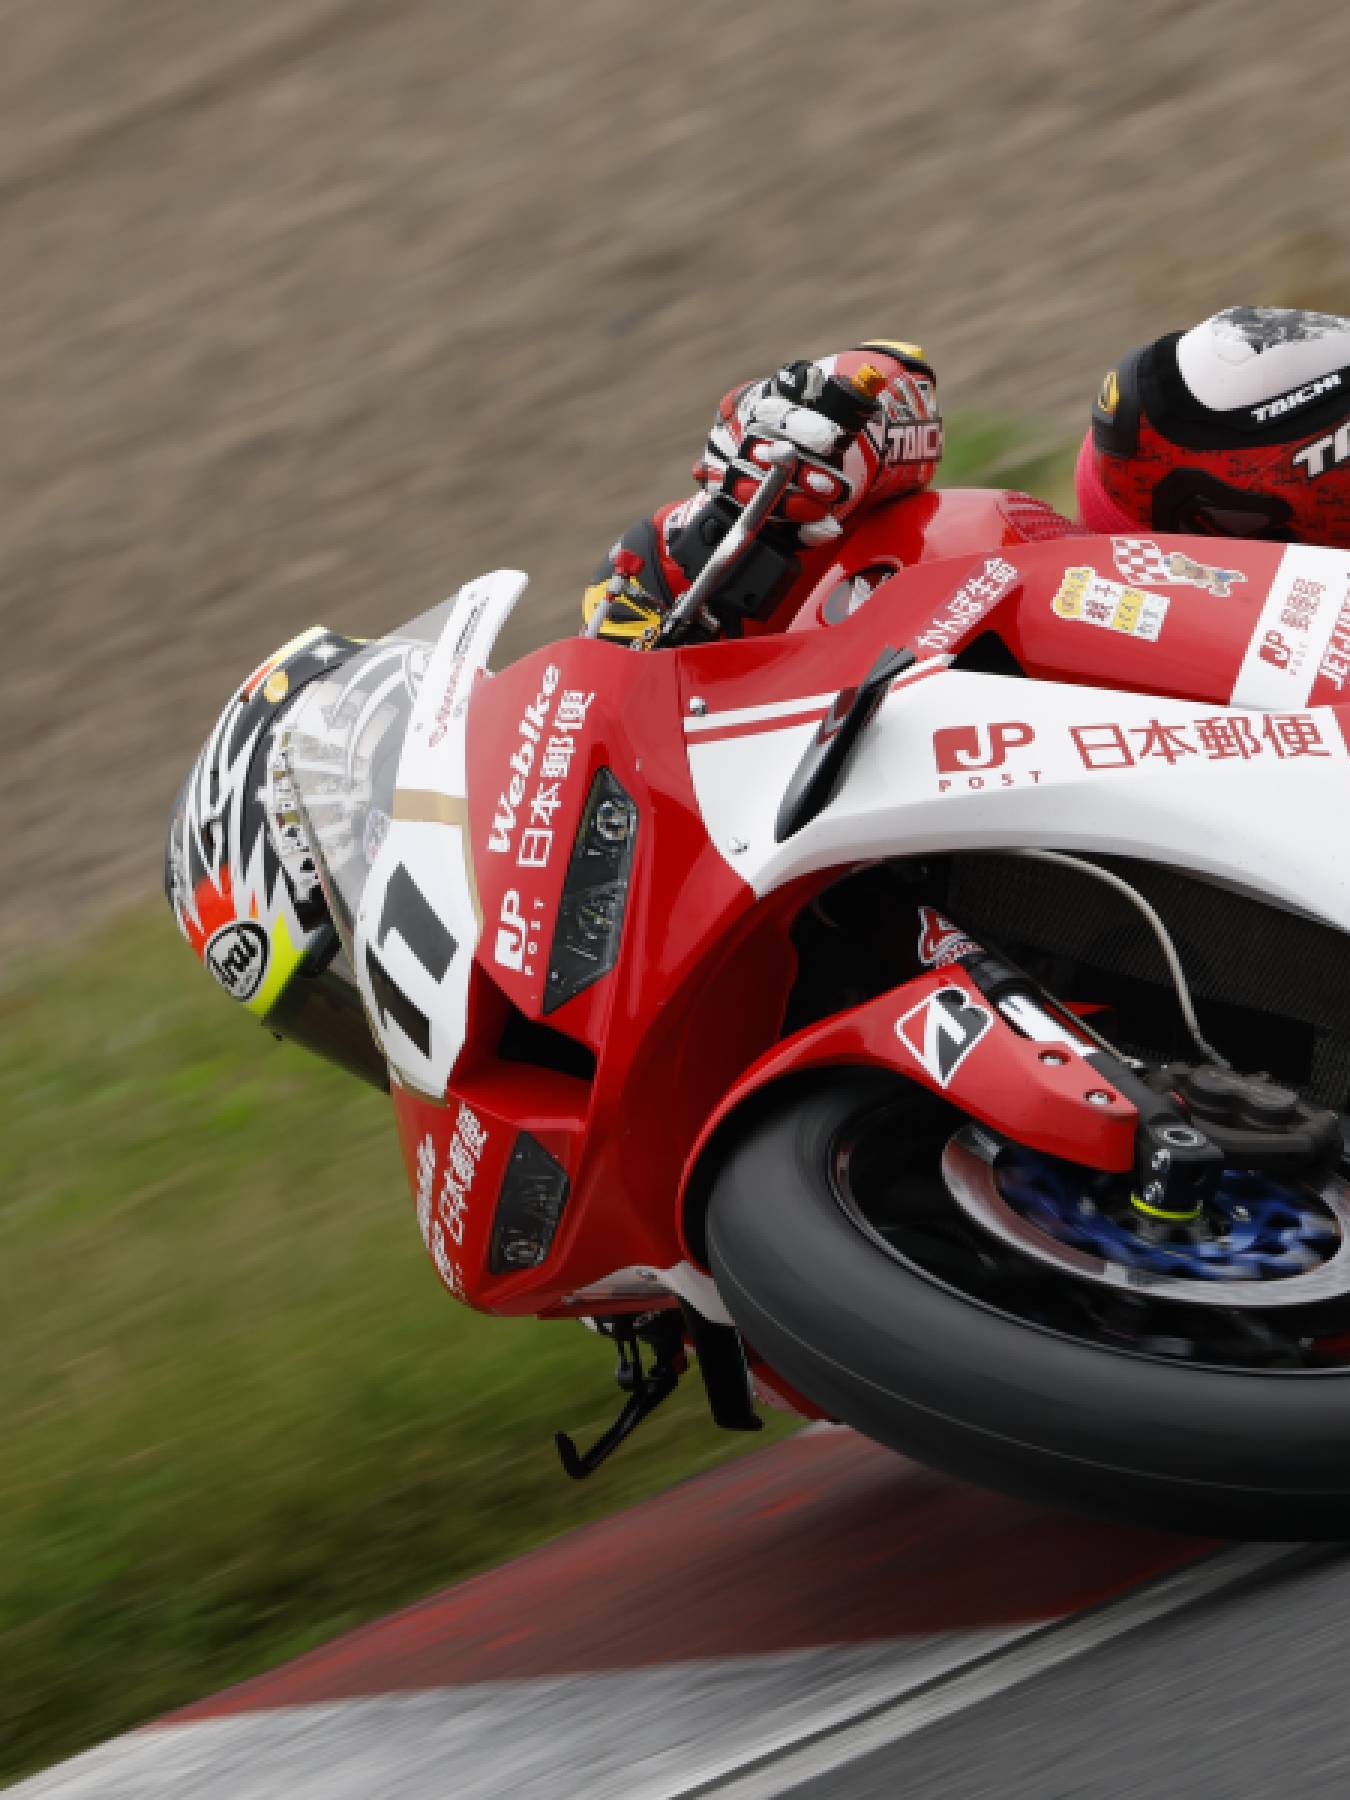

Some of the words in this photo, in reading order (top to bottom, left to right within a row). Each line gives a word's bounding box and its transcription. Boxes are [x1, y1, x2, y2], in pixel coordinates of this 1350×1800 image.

[1250, 374, 1342, 423] TAICHI
[887, 423, 944, 461] TAIC
[487, 663, 560, 852] Webike
[932, 721, 1036, 774] JP
[1067, 713, 1331, 771] 日本郵便
[938, 769, 1042, 793] POST
